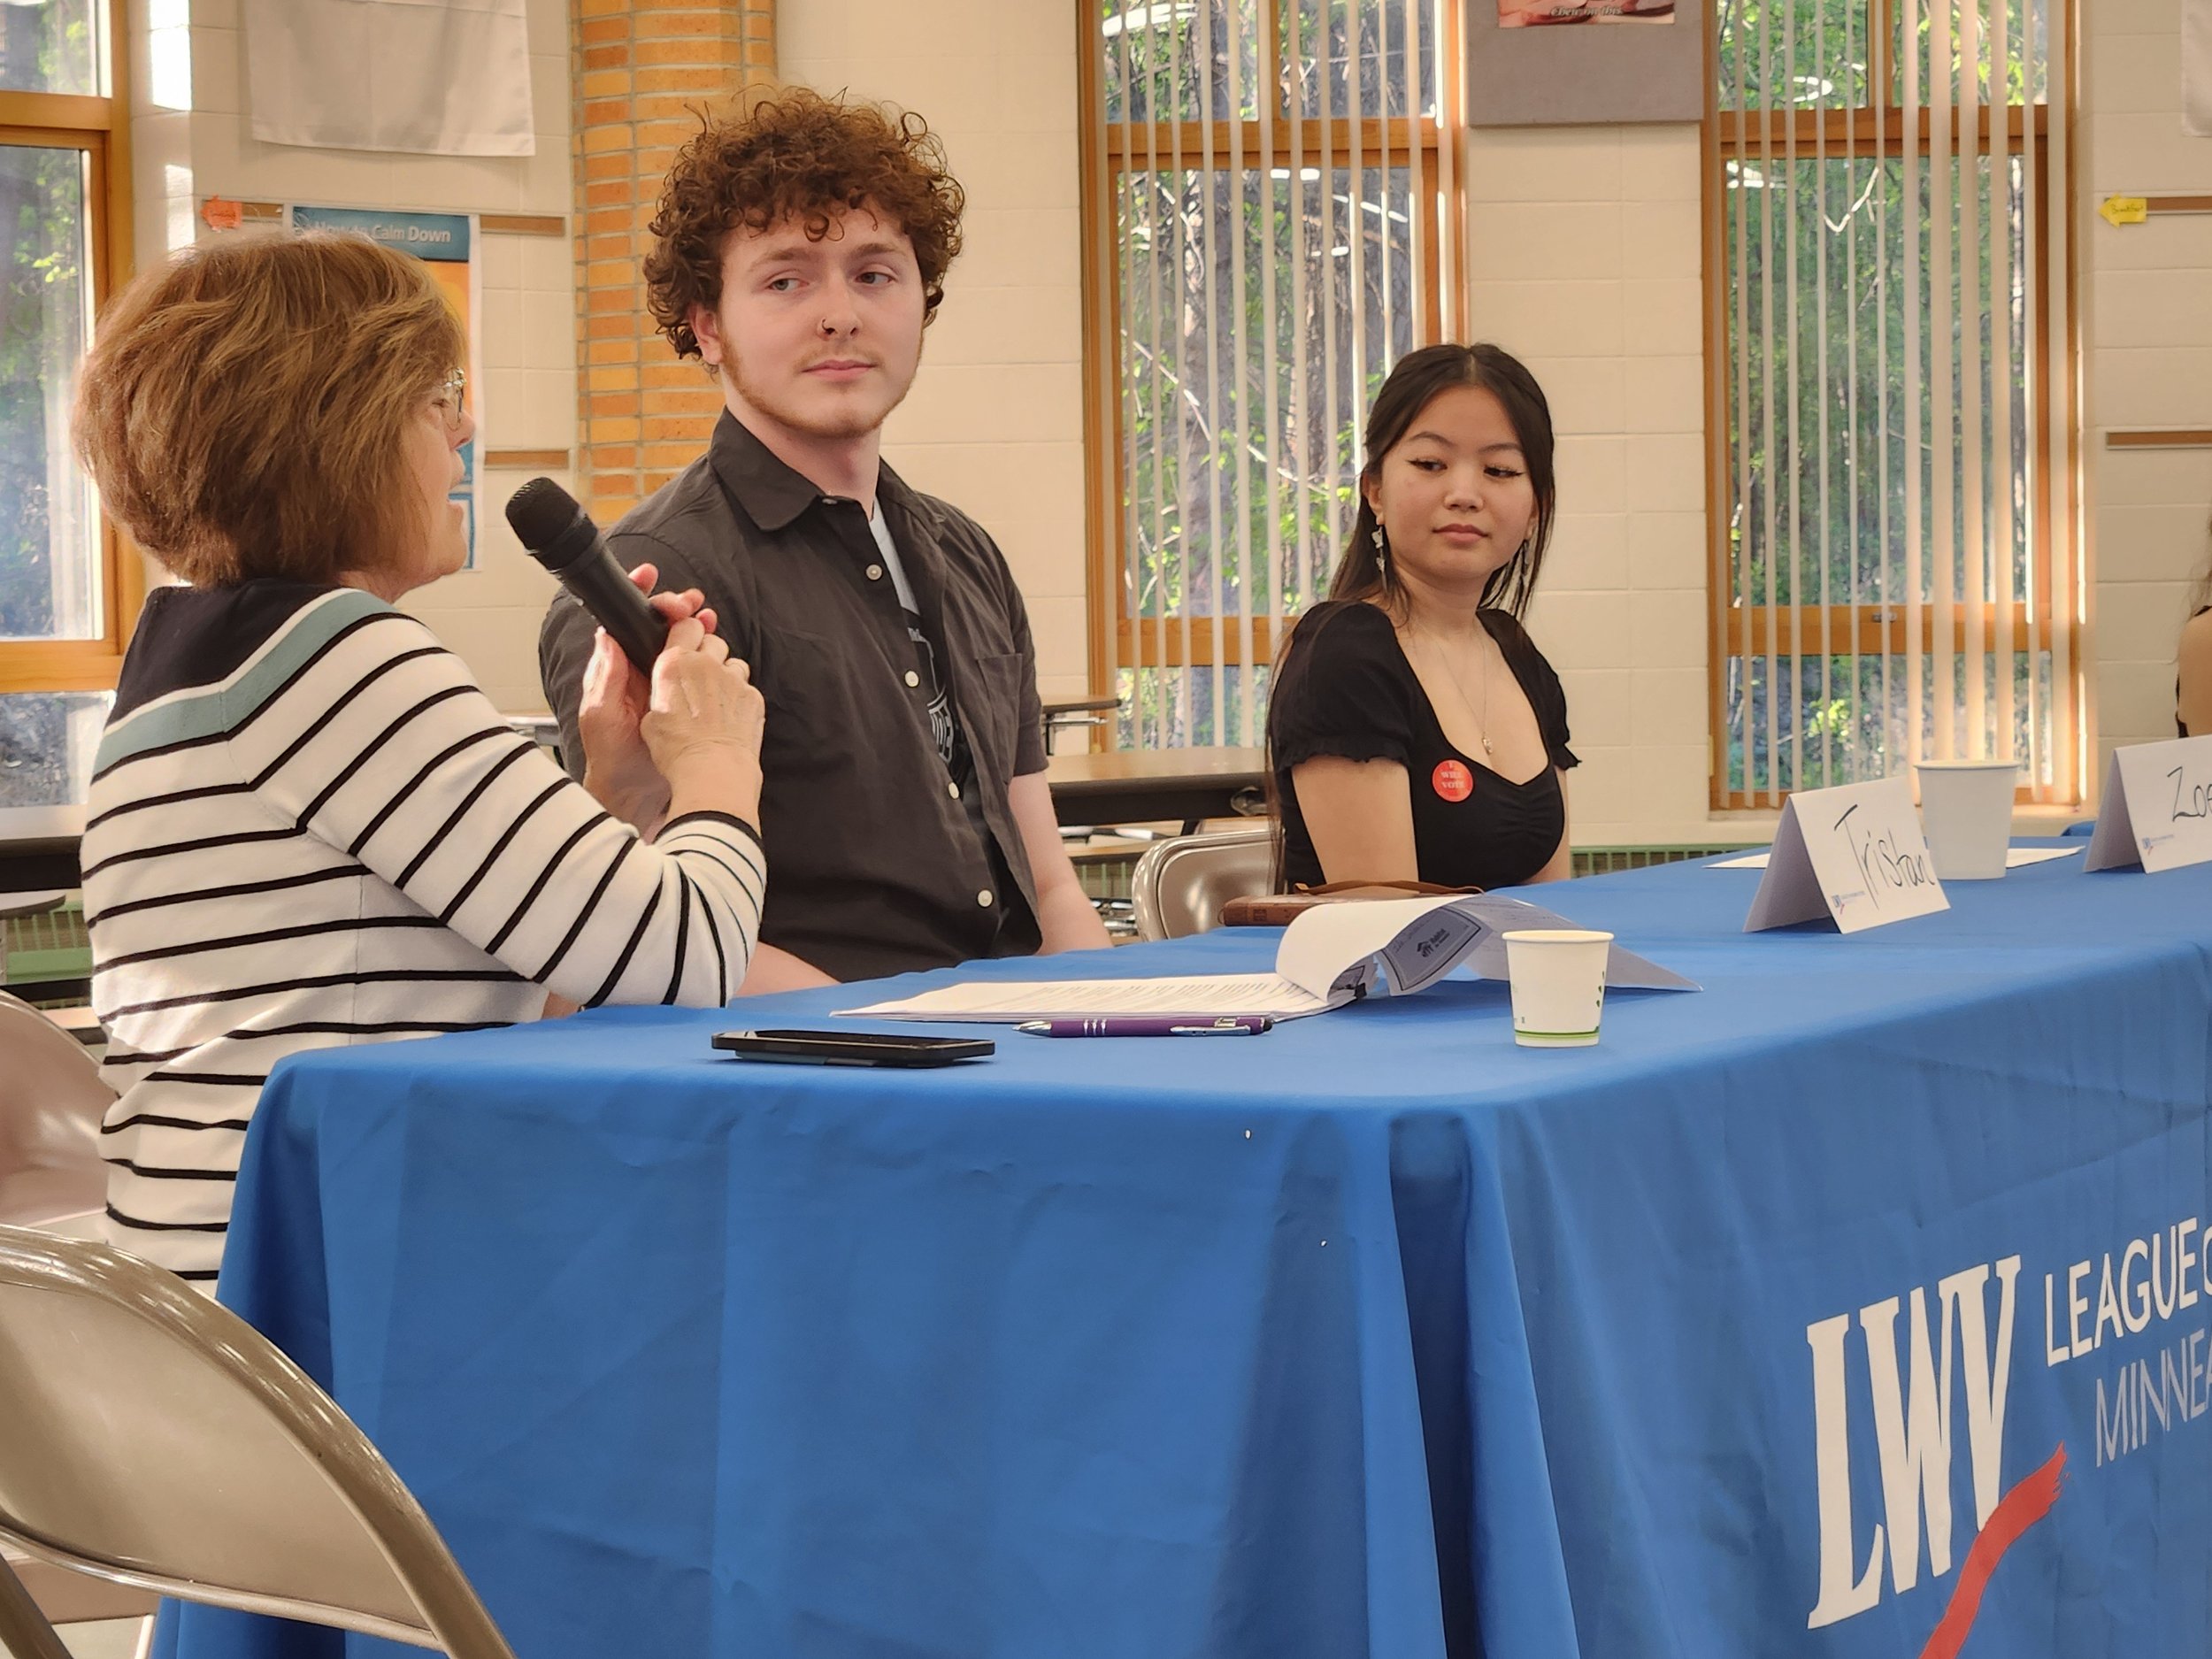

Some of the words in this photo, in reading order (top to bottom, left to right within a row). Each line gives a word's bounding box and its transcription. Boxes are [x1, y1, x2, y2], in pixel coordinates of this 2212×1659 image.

[372, 224, 405, 240] Calm
[408, 226, 451, 242] Down
[1833, 803, 1936, 911] Tristan
[2045, 1217, 2199, 1367] LEAGUE
[1807, 1254, 2022, 1629] LWV
